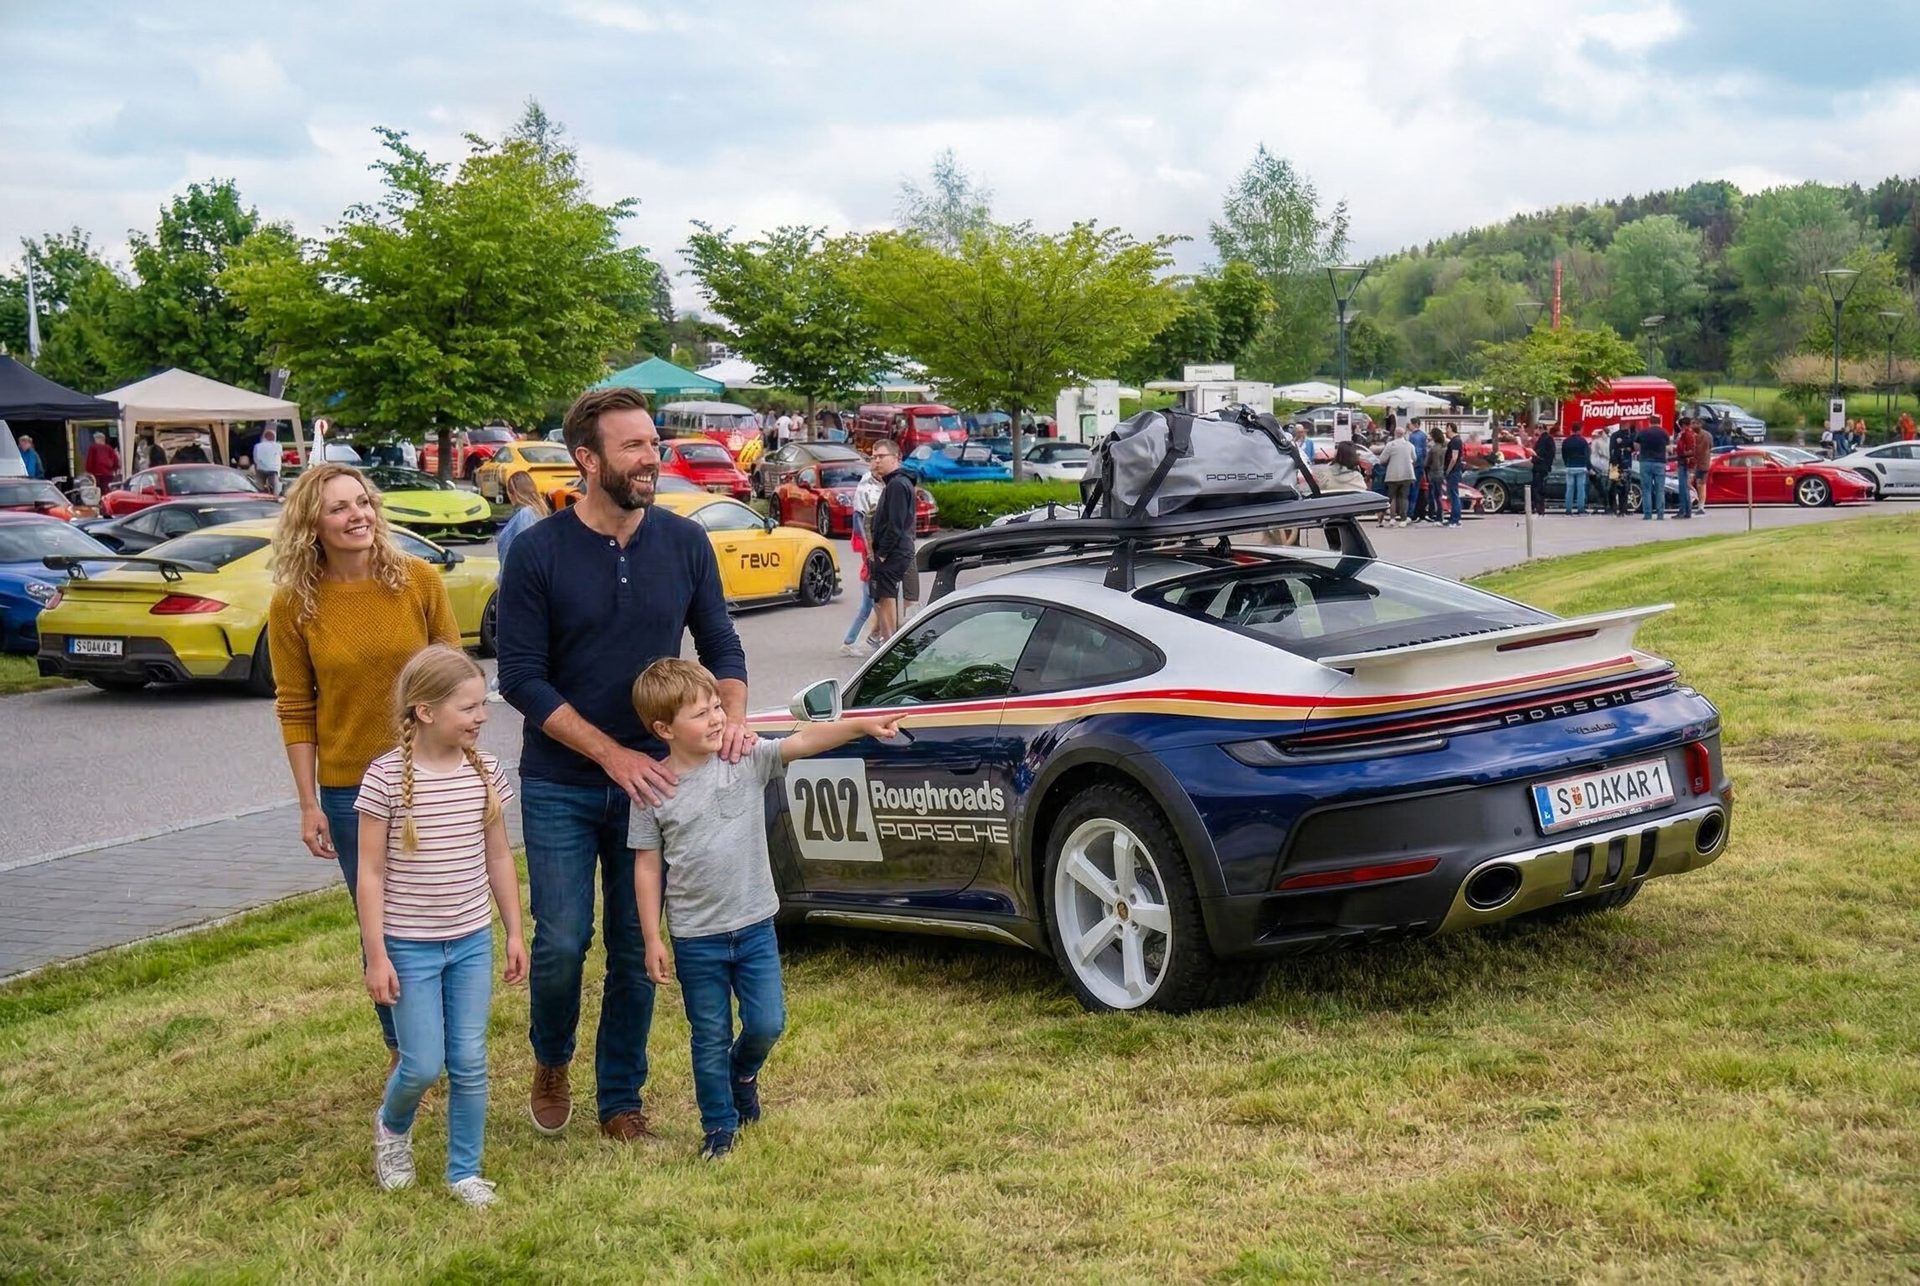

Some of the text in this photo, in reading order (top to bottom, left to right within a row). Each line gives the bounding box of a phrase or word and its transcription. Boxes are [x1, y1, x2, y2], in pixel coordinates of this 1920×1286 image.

[1585, 402, 1652, 419] Roughroads
[1206, 472, 1274, 481] PORSCHE
[1505, 690, 1642, 725] PORSCHE
[794, 777, 869, 843] 202
[870, 780, 1005, 816] Roughroads
[1557, 787, 1572, 815] S
[878, 822, 1010, 844] PORSCHE
